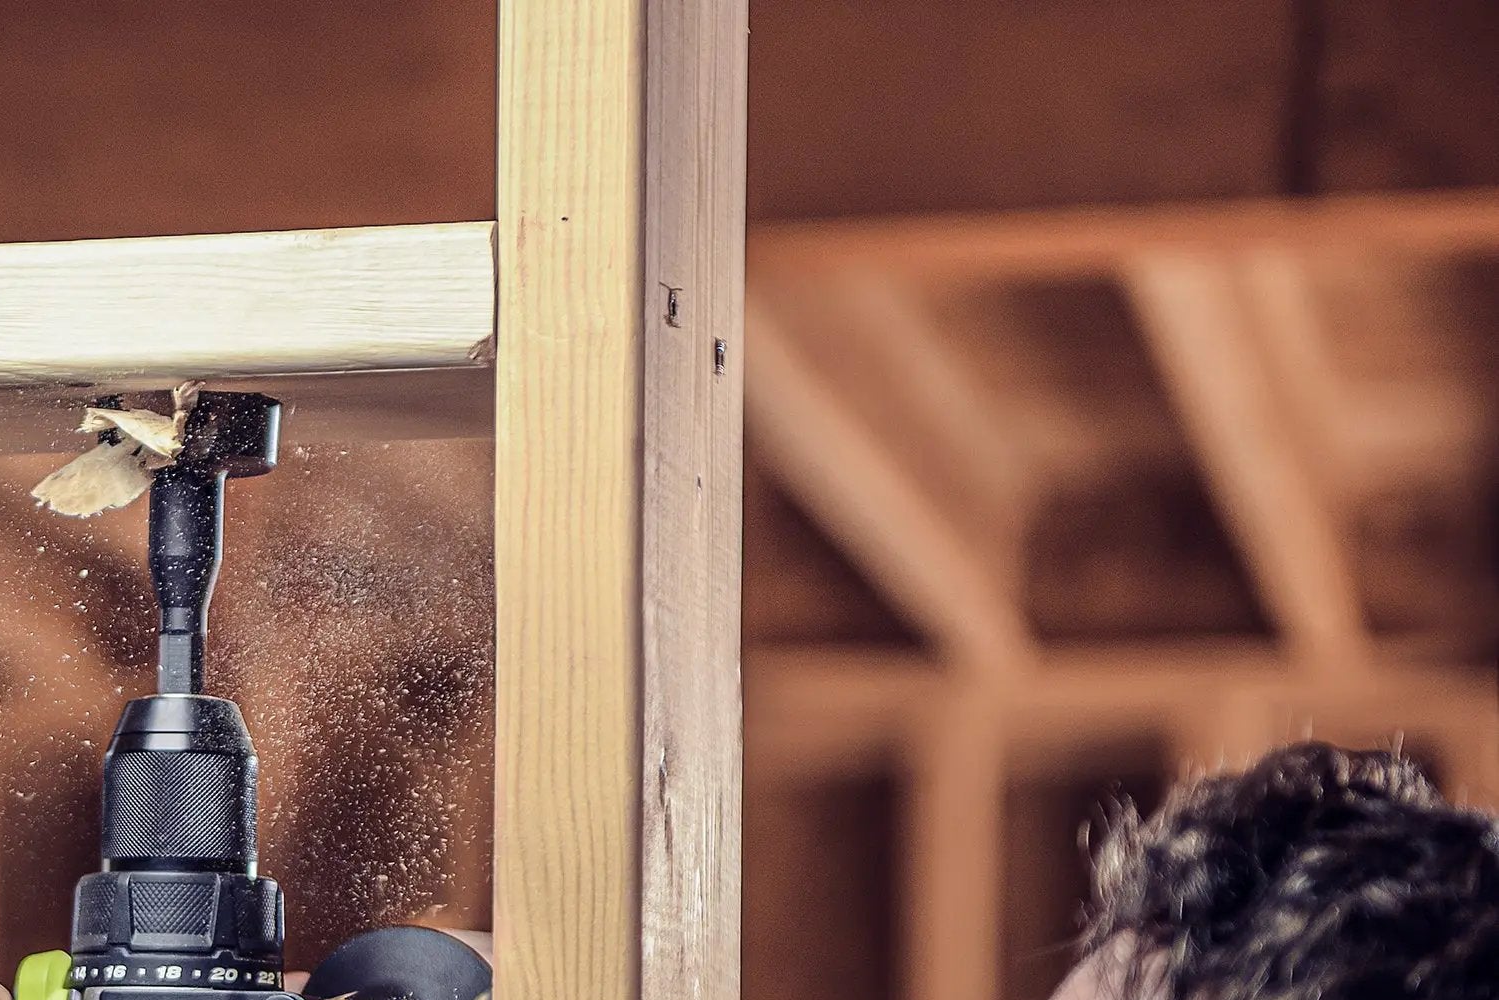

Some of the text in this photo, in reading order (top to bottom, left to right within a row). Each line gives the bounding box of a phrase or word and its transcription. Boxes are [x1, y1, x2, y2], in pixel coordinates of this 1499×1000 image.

[73, 965, 275, 985] 14 16 18 20 22
